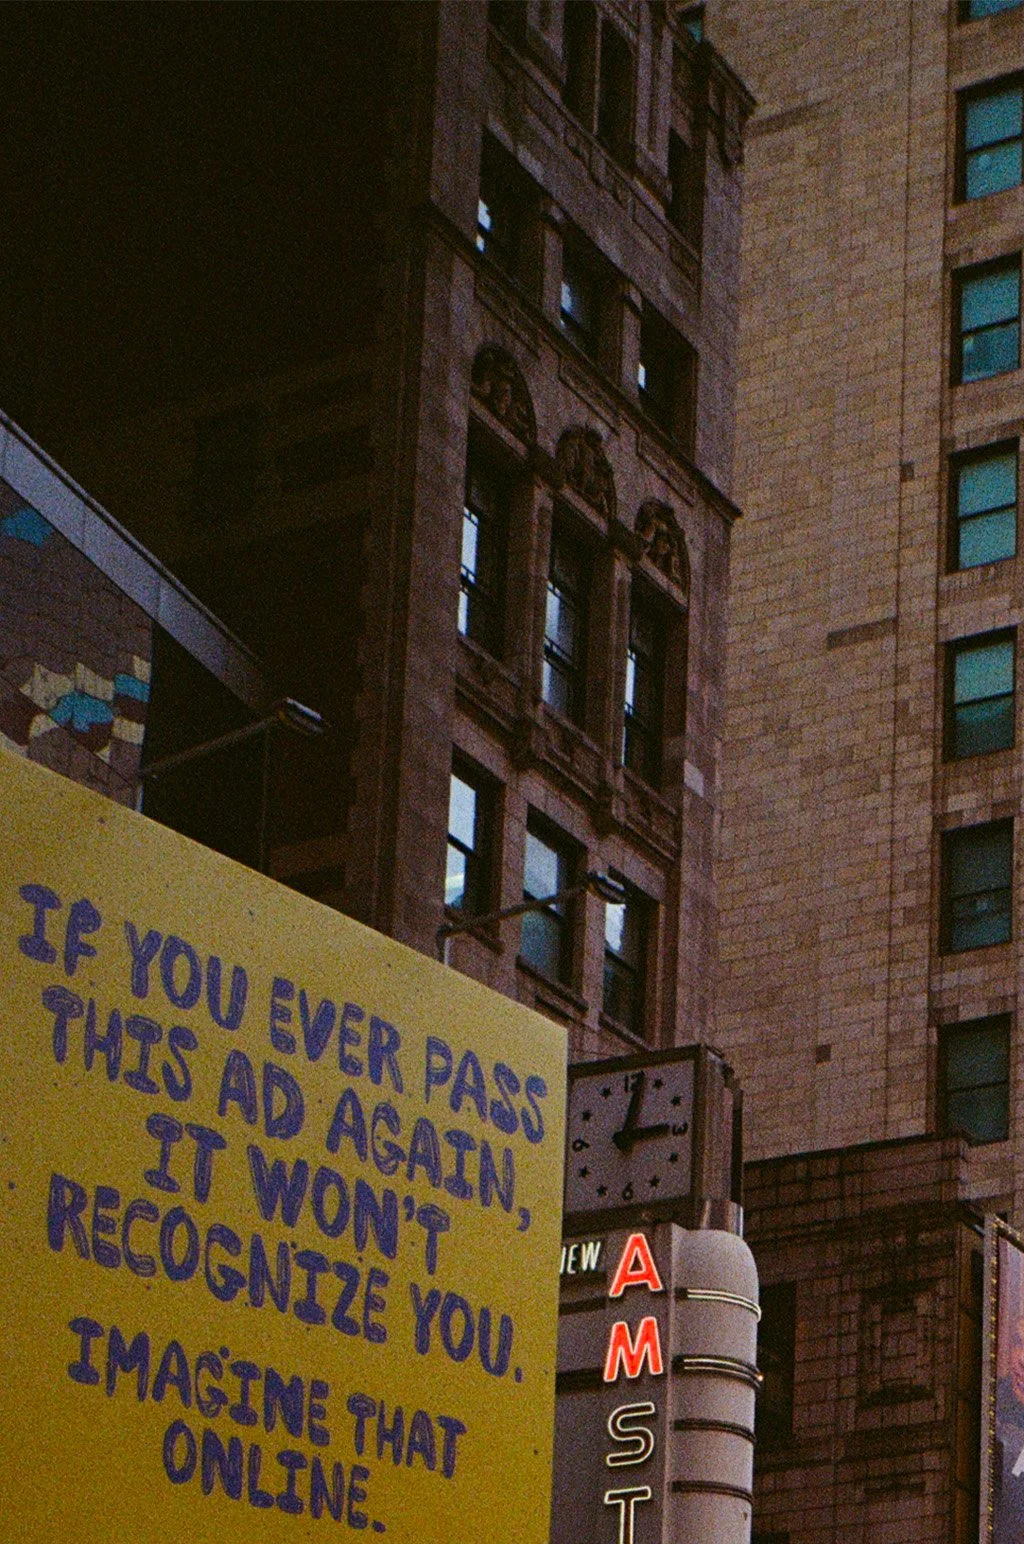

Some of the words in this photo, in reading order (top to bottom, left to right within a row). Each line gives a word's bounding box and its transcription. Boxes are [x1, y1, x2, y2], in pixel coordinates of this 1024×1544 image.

[18, 884, 101, 976] IF
[123, 921, 248, 1031] YOU
[271, 976, 402, 1094] EVER
[425, 1035, 548, 1144] PASS
[42, 985, 198, 1100] THIS
[219, 1050, 305, 1140] AD
[326, 1088, 531, 1232] AGAIN,
[145, 1114, 226, 1201] IT
[248, 1144, 450, 1275] WON'T
[46, 1173, 390, 1345] RECOGNIZE
[410, 1282, 523, 1384] YOU.
[67, 1316, 331, 1447] IMAGINE
[347, 1392, 468, 1479] THAT
[162, 1419, 386, 1534] ONLINE.
